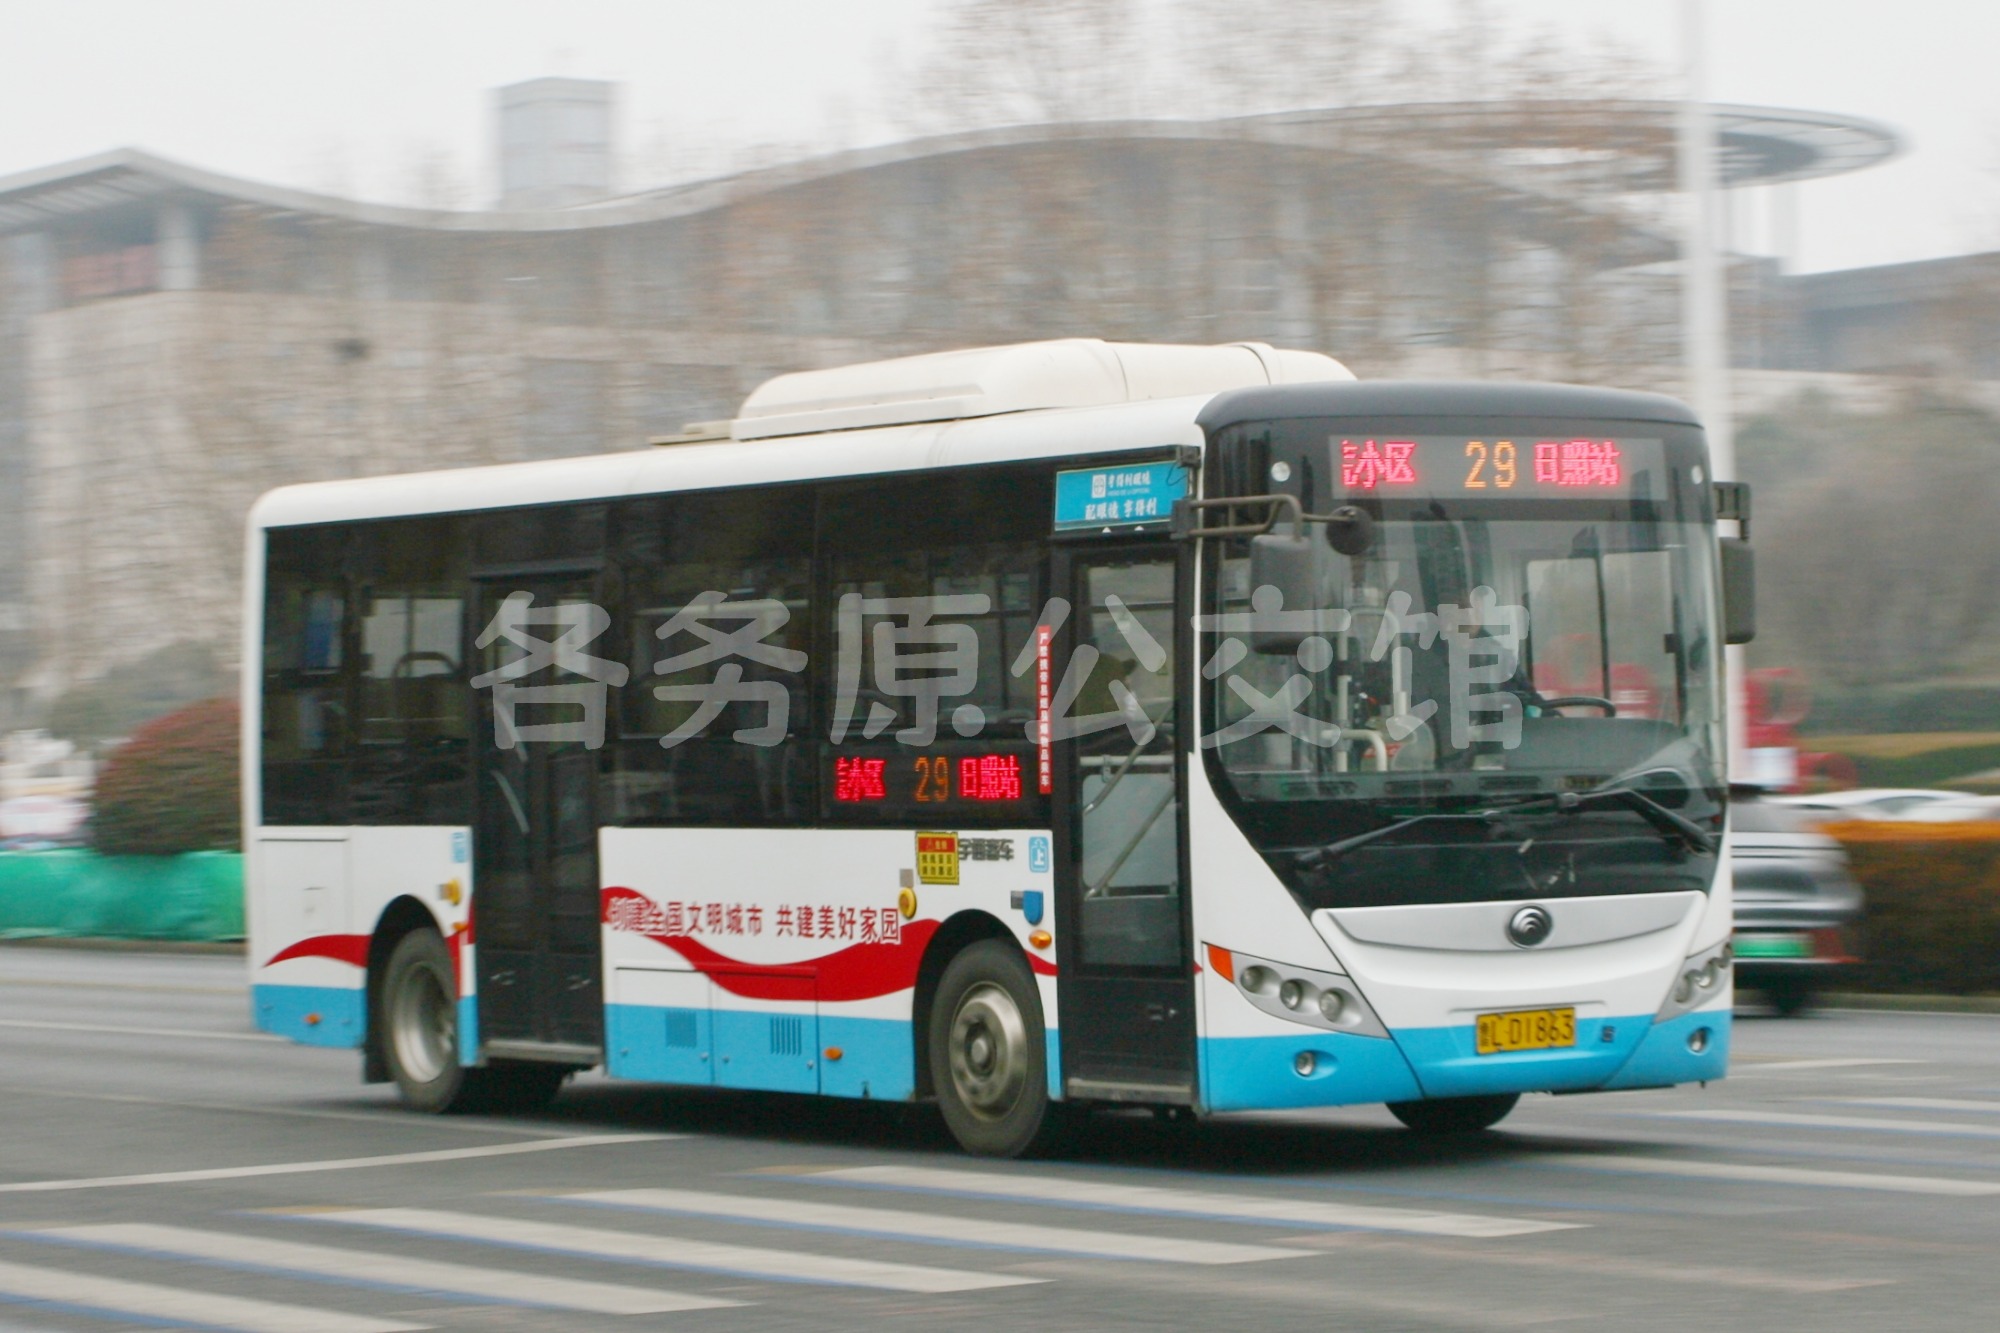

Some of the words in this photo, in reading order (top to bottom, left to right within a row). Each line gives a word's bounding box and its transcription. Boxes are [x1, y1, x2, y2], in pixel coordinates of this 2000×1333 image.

[1464, 441, 1517, 488] 29
[1534, 441, 1621, 486] 日照站
[915, 756, 950, 802] 29
[959, 754, 1023, 799] 日照站
[775, 904, 901, 945] 共建美好家园
